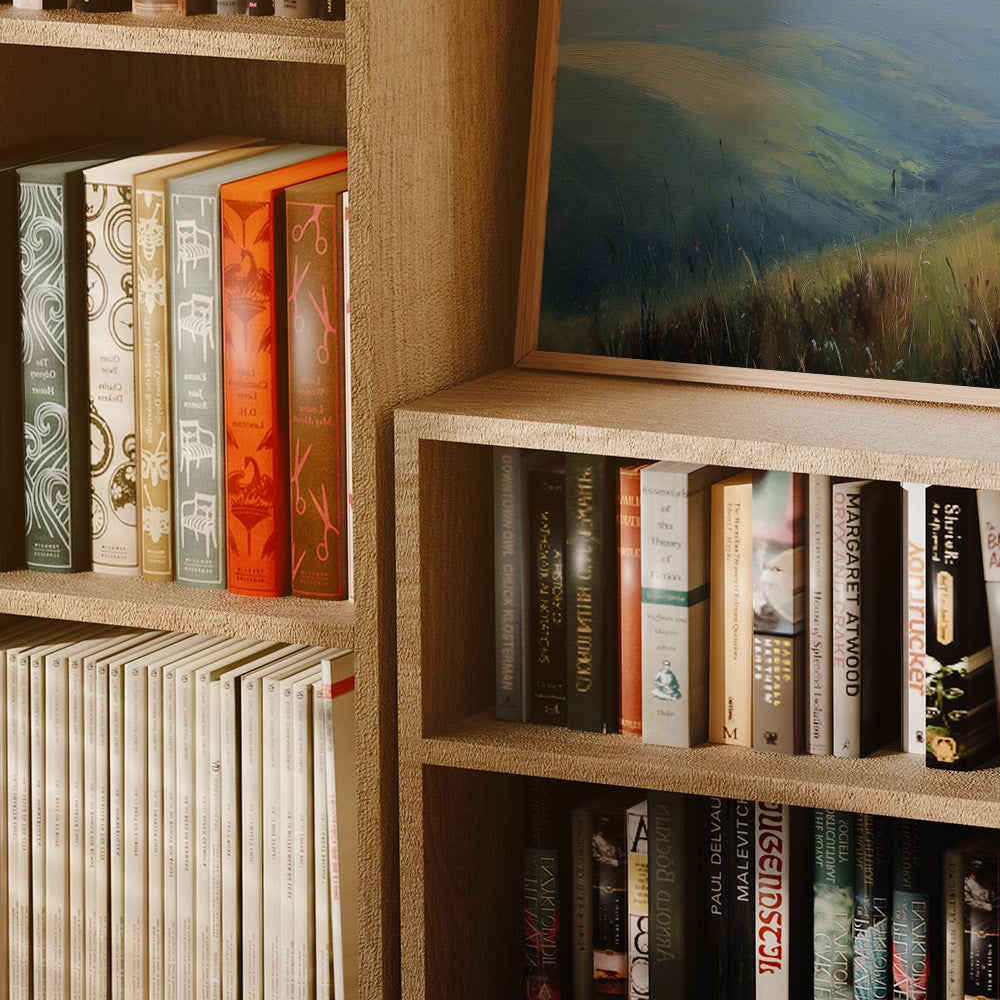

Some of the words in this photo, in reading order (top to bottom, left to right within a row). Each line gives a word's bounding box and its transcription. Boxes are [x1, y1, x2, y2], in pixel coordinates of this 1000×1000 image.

[651, 536, 682, 550] Theory
[834, 492, 846, 543] ORYX
[834, 550, 845, 593] AND
[846, 492, 860, 603] MARGARET
[834, 598, 846, 670] CRAKE
[845, 610, 860, 697] ATWOOD
[710, 871, 723, 915] PAUL
